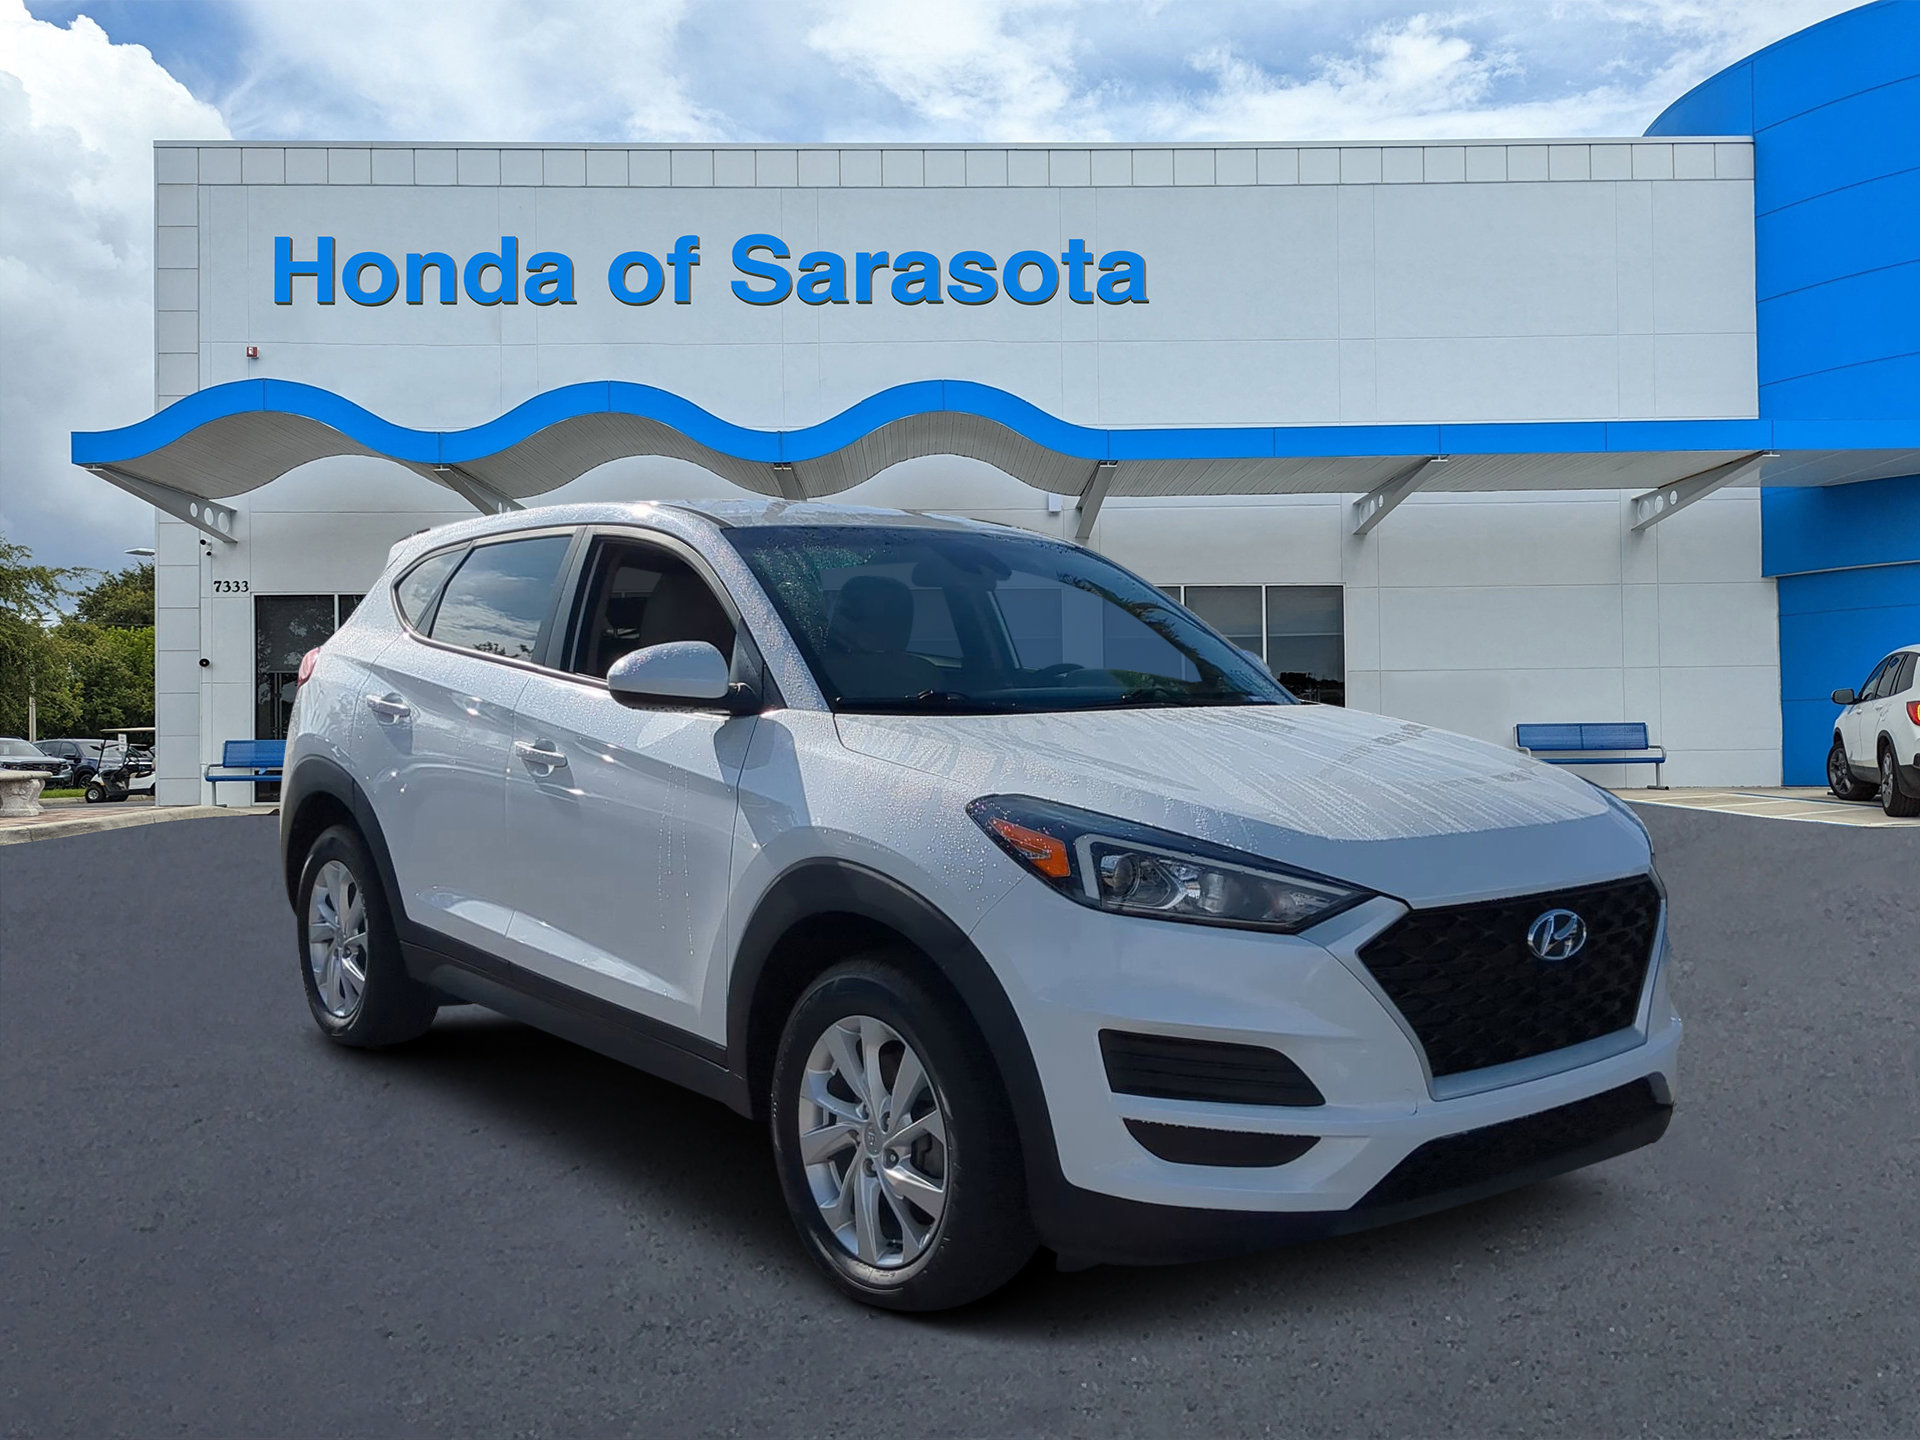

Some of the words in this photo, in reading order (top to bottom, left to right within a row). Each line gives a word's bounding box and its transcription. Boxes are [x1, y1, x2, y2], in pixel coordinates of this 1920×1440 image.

[273, 235, 577, 306] Honda
[607, 234, 700, 306] of
[730, 233, 1150, 306] Sarasota
[213, 580, 249, 593] 7333
